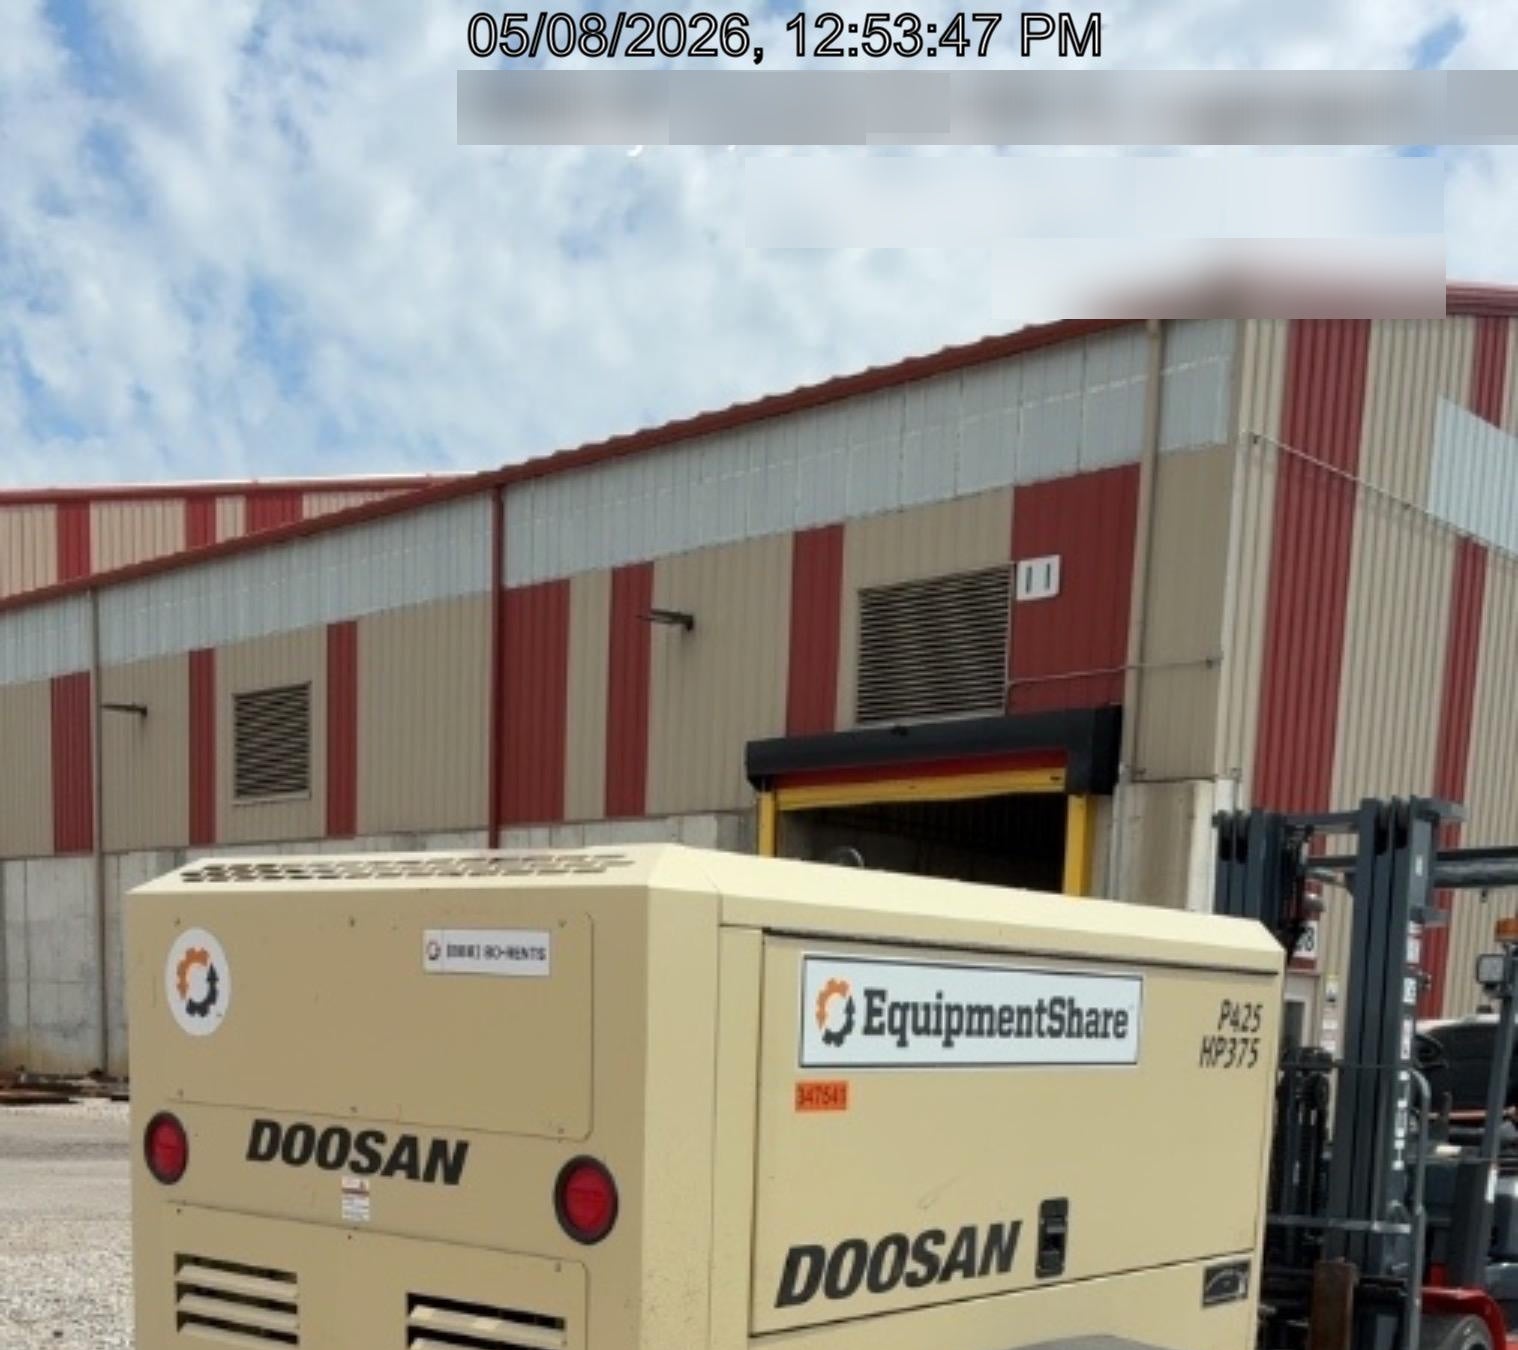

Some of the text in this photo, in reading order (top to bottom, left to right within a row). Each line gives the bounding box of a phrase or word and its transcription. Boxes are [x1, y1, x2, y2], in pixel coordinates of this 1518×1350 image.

[1024, 563, 1051, 594] 11
[862, 988, 1128, 1048] EquipmentShare
[1217, 998, 1263, 1033] P425
[1199, 1035, 1261, 1069] HP375
[245, 1118, 469, 1185] DOOSAN
[773, 1219, 1023, 1309] DOOSAN
